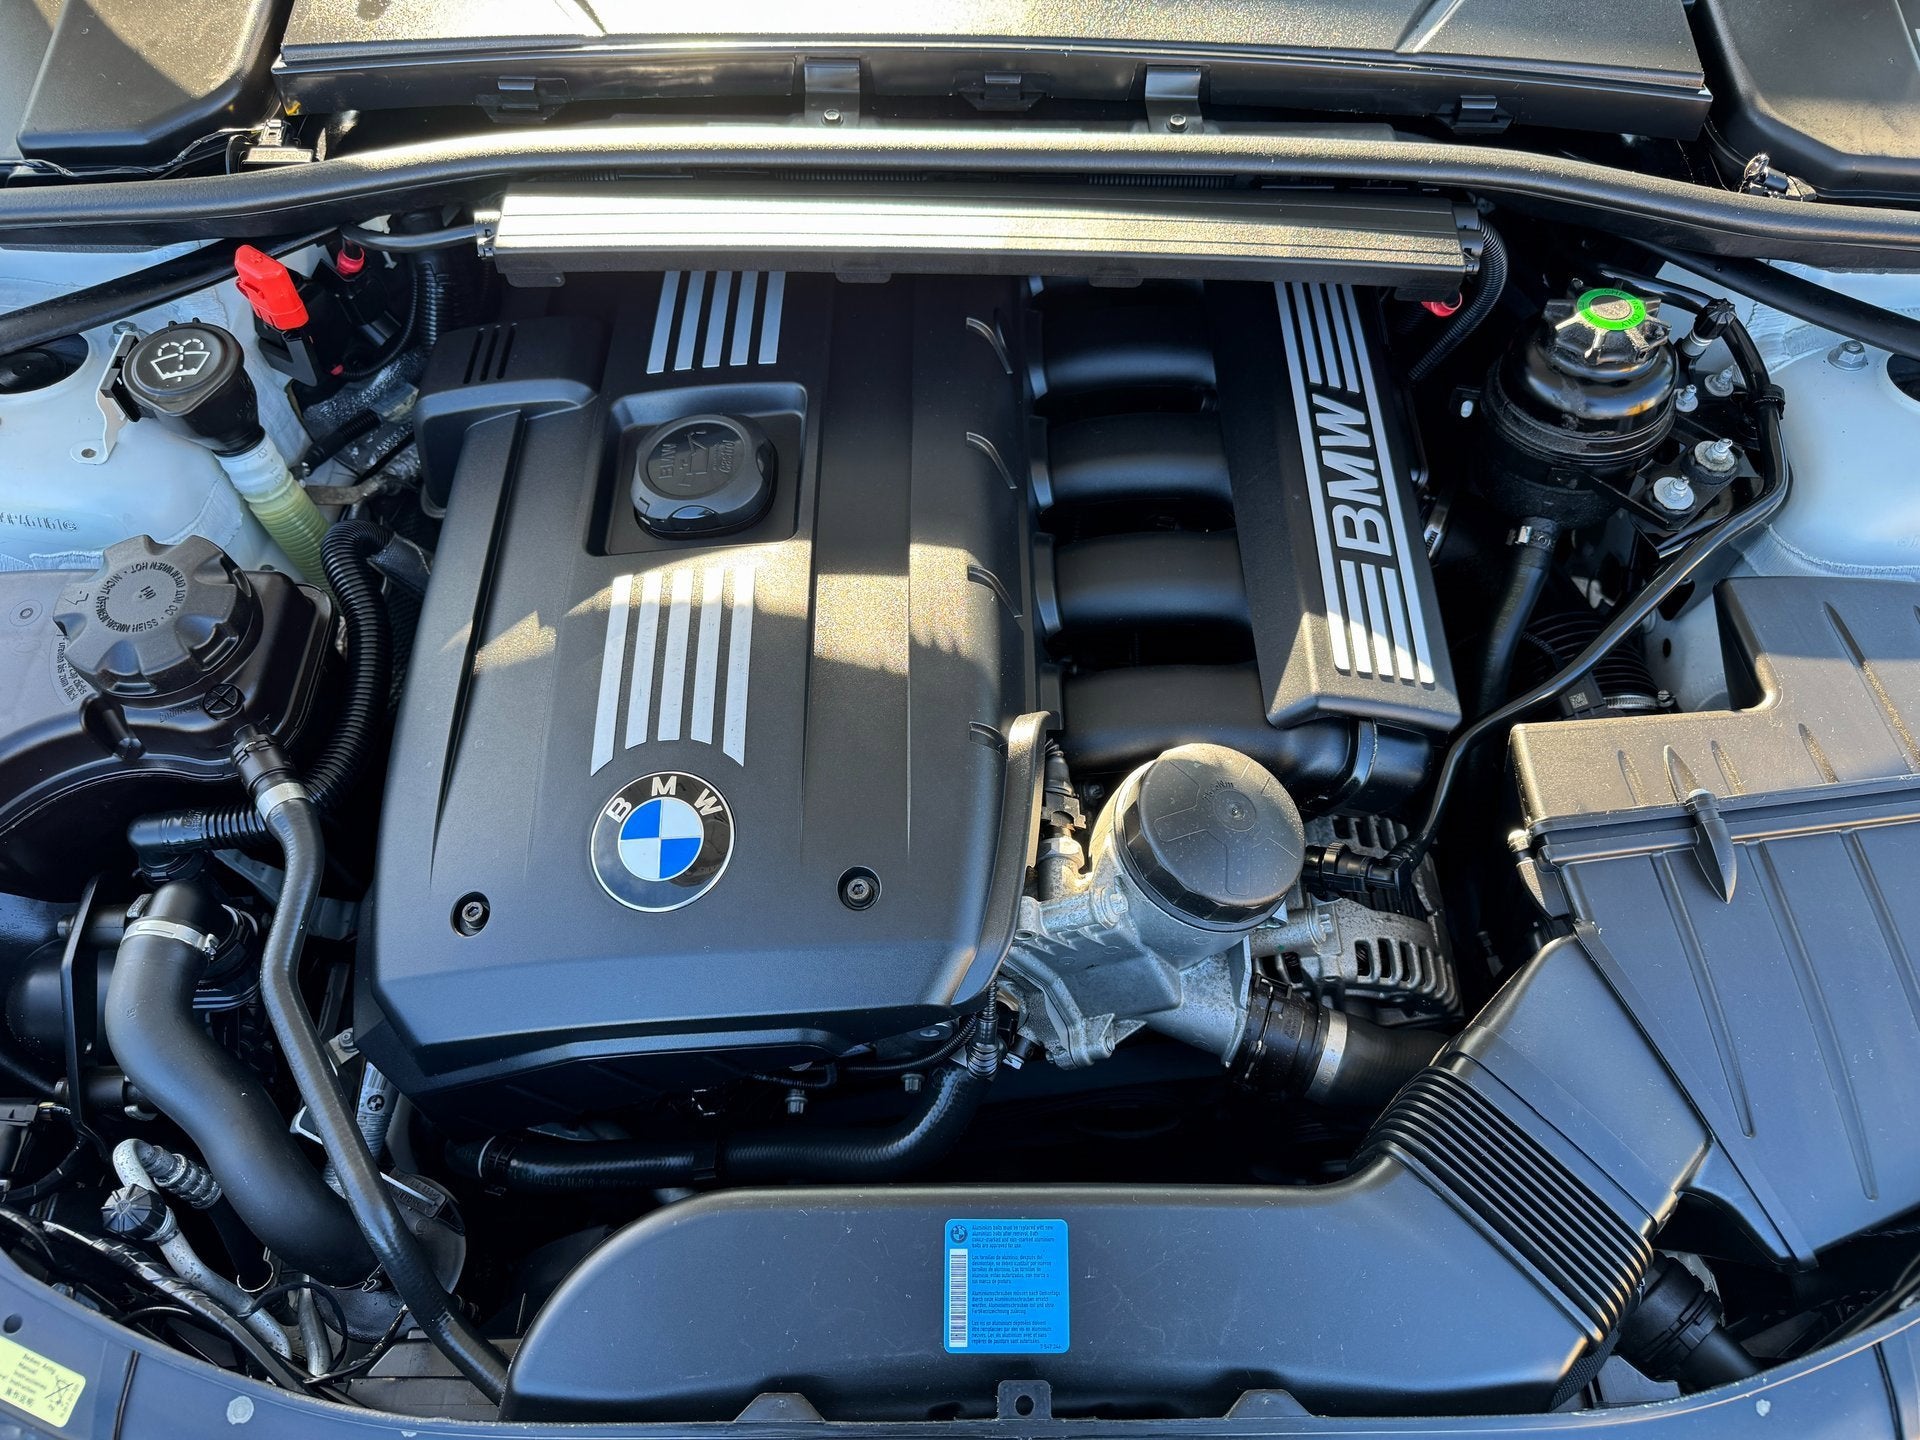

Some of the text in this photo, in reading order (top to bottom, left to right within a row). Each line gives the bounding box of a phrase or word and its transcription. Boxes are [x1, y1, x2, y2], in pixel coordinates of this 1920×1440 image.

[658, 443, 677, 479] BMW
[1312, 393, 1392, 556] BMW
[130, 561, 149, 574] HOT
[149, 561, 175, 575] WHEN
[99, 573, 123, 595] NICHT
[172, 589, 186, 605] NOT
[164, 604, 179, 616] DO
[105, 618, 131, 633] WENN
[131, 618, 159, 633] HEISS
[605, 775, 724, 824] BMW
